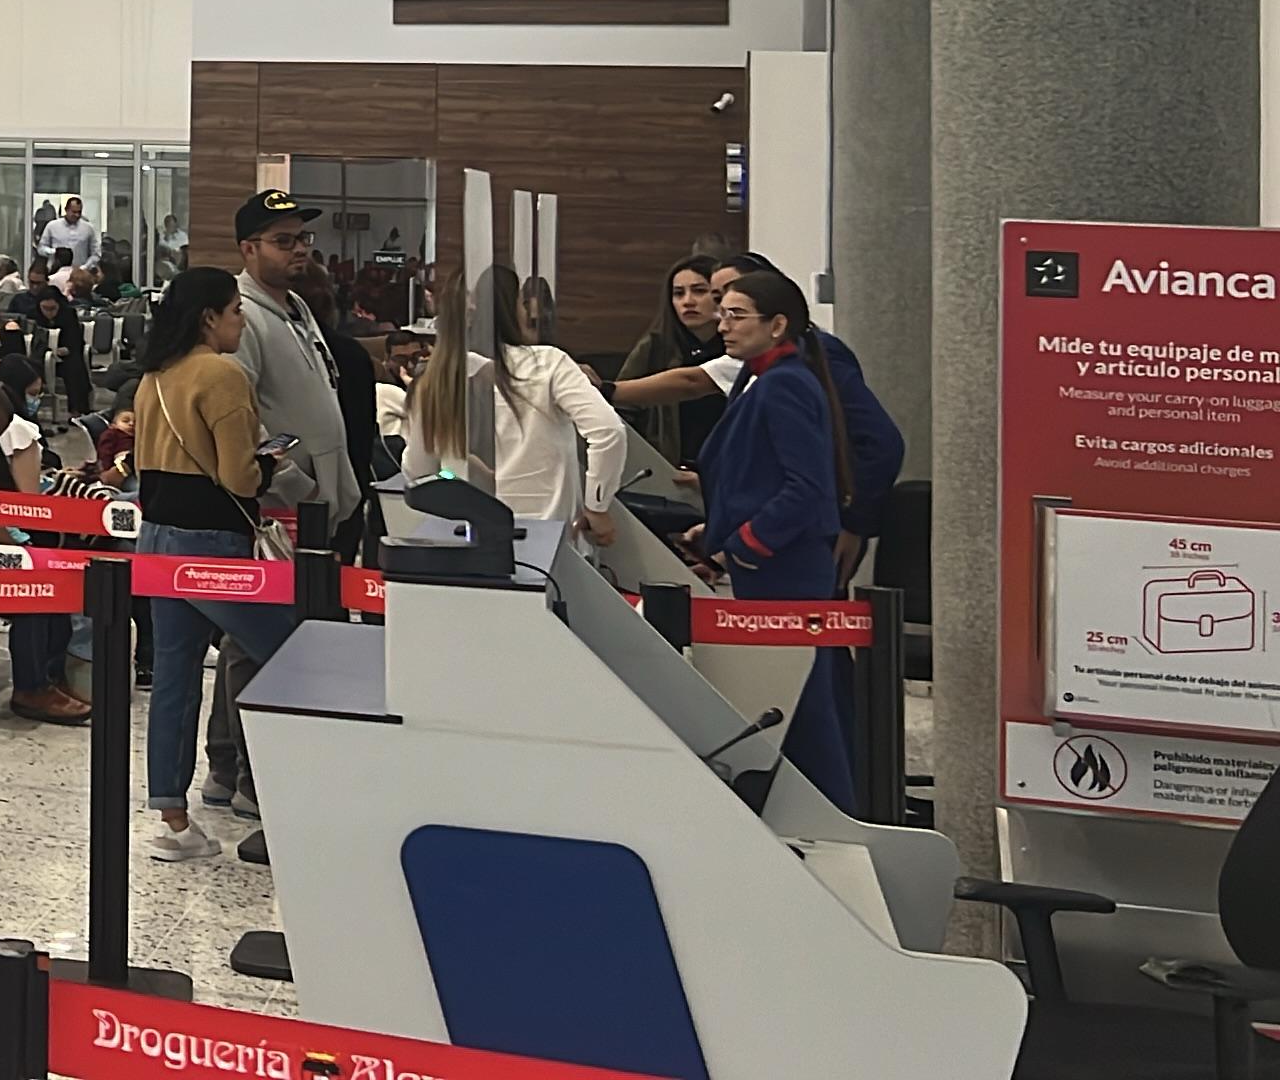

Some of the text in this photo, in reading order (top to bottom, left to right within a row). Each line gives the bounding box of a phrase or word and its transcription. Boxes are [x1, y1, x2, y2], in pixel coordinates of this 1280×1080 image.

[1101, 259, 1276, 299] Avianca
[1038, 336, 1094, 355] Mide
[1099, 340, 1122, 356] tu
[1127, 342, 1222, 364] equipaje
[1227, 345, 1254, 362] de
[1077, 359, 1280, 384] y artículo personal
[1059, 386, 1124, 402] Measure
[1127, 391, 1161, 406] your
[1233, 395, 1280, 413] luggag
[1108, 405, 1241, 423] and personal item
[1075, 434, 1274, 460] Evita cargos adicionales
[1094, 456, 1132, 469] Avoid
[1168, 538, 1212, 552] 45 cm
[825, 611, 872, 630] Alem
[1086, 631, 1128, 646] 25 cm
[1153, 749, 1211, 765] Prohibido
[1225, 768, 1271, 781] inflama
[92, 1008, 290, 1080] Droguería
